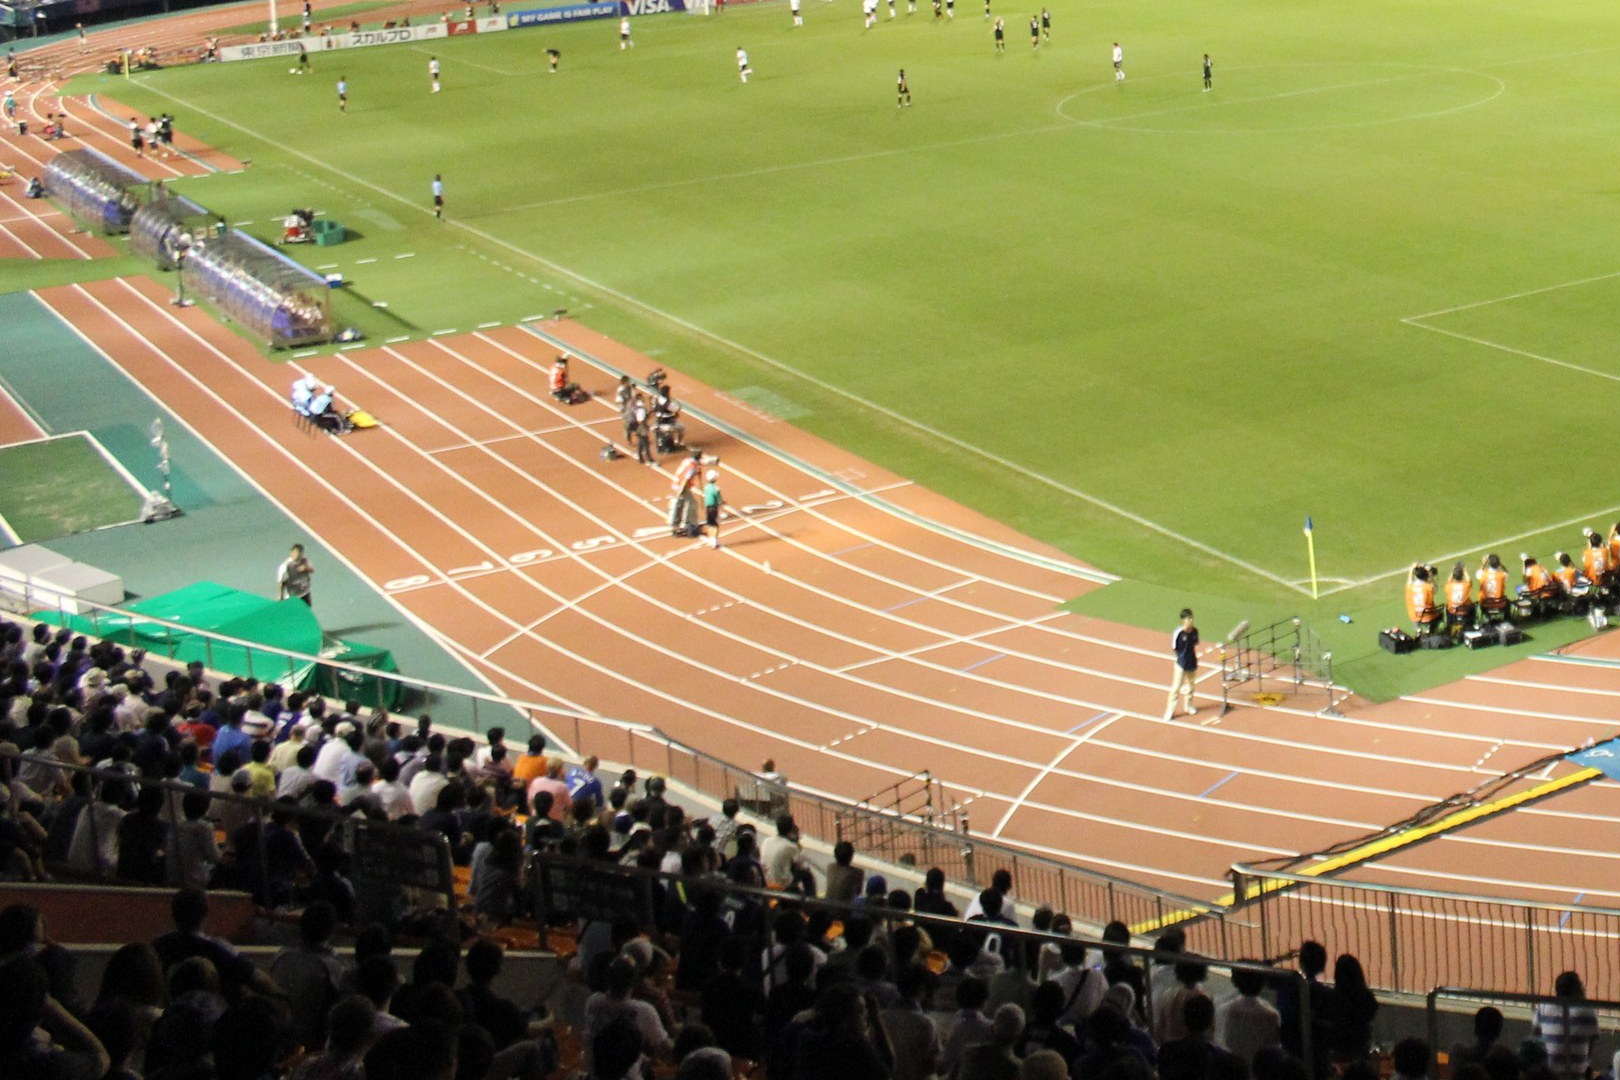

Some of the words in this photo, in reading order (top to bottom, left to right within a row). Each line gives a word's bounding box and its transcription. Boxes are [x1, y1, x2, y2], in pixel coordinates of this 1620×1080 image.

[572, 535, 616, 550] 5
[509, 549, 553, 563] 6
[384, 574, 430, 590] 8
